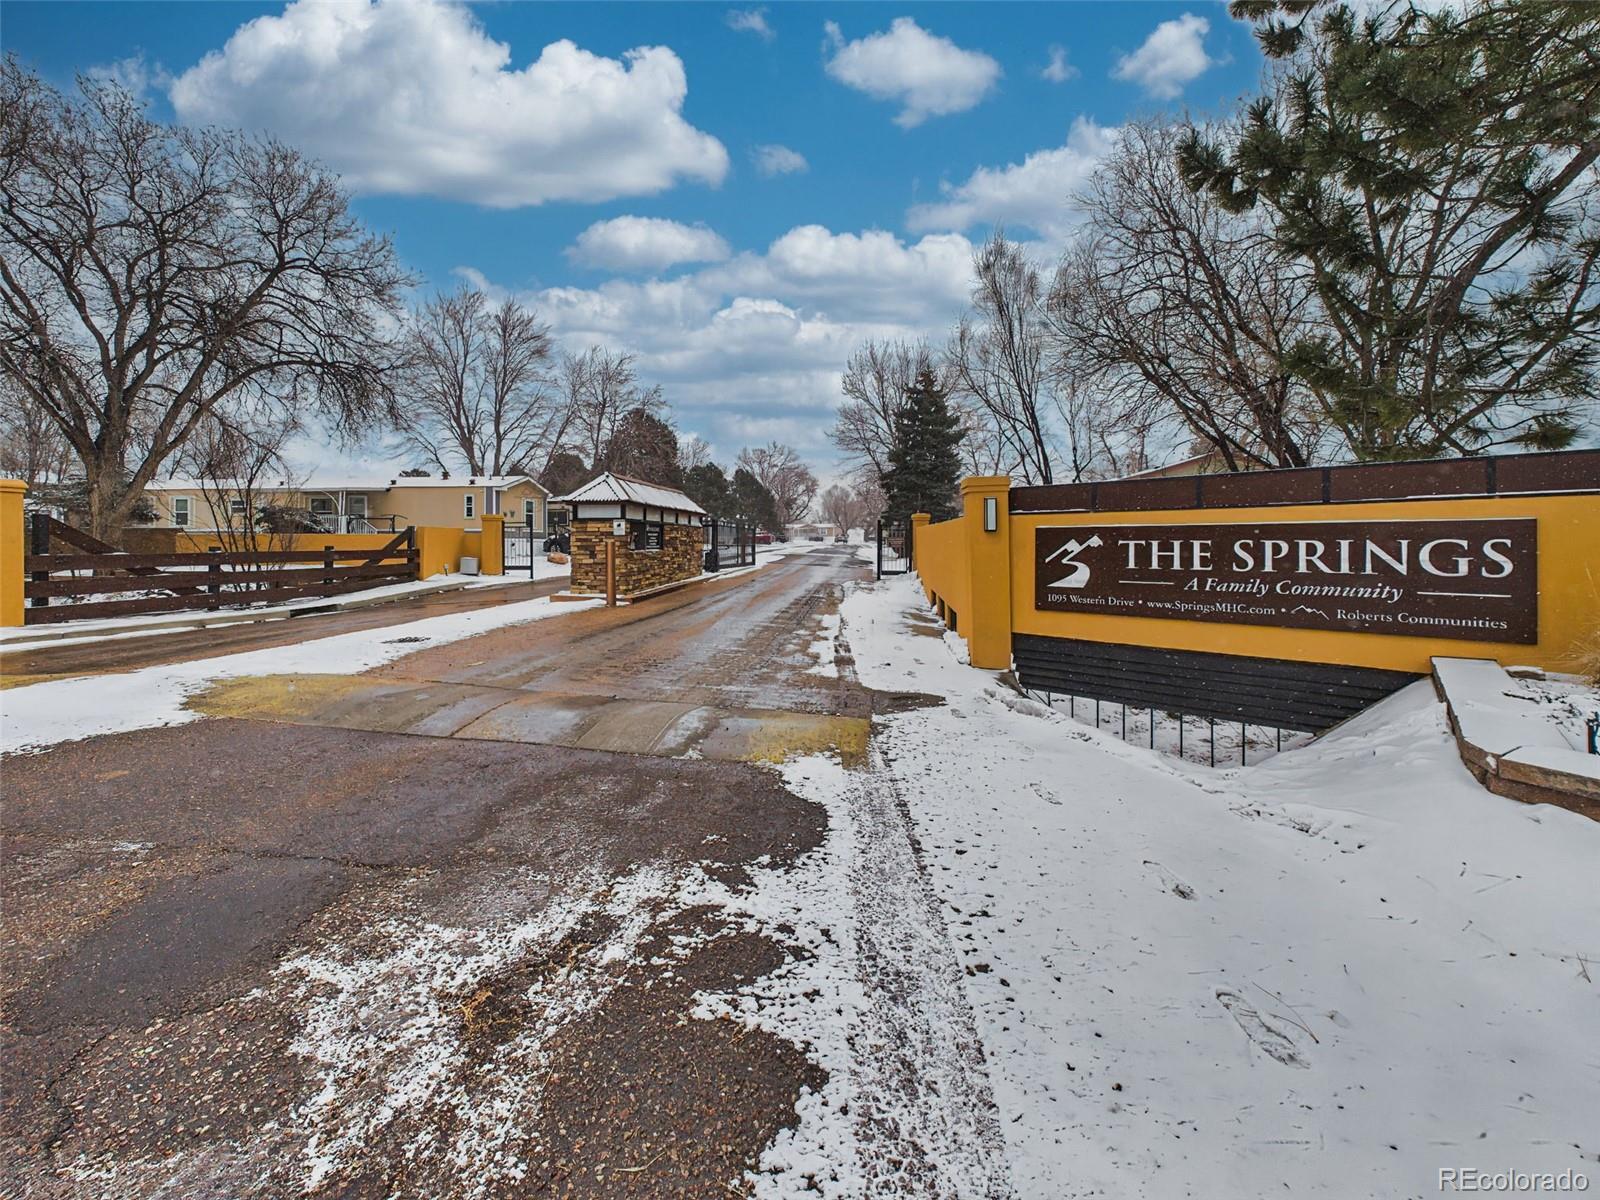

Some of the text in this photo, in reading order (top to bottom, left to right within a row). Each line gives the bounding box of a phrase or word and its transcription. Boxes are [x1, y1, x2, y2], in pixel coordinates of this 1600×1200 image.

[1117, 538, 1514, 578] THE SPRINGS
[1184, 577, 1403, 604] A Family Community
[1047, 593, 1508, 629] 1095 Western Drive www.SpringsMHC.com Roberts Communities
